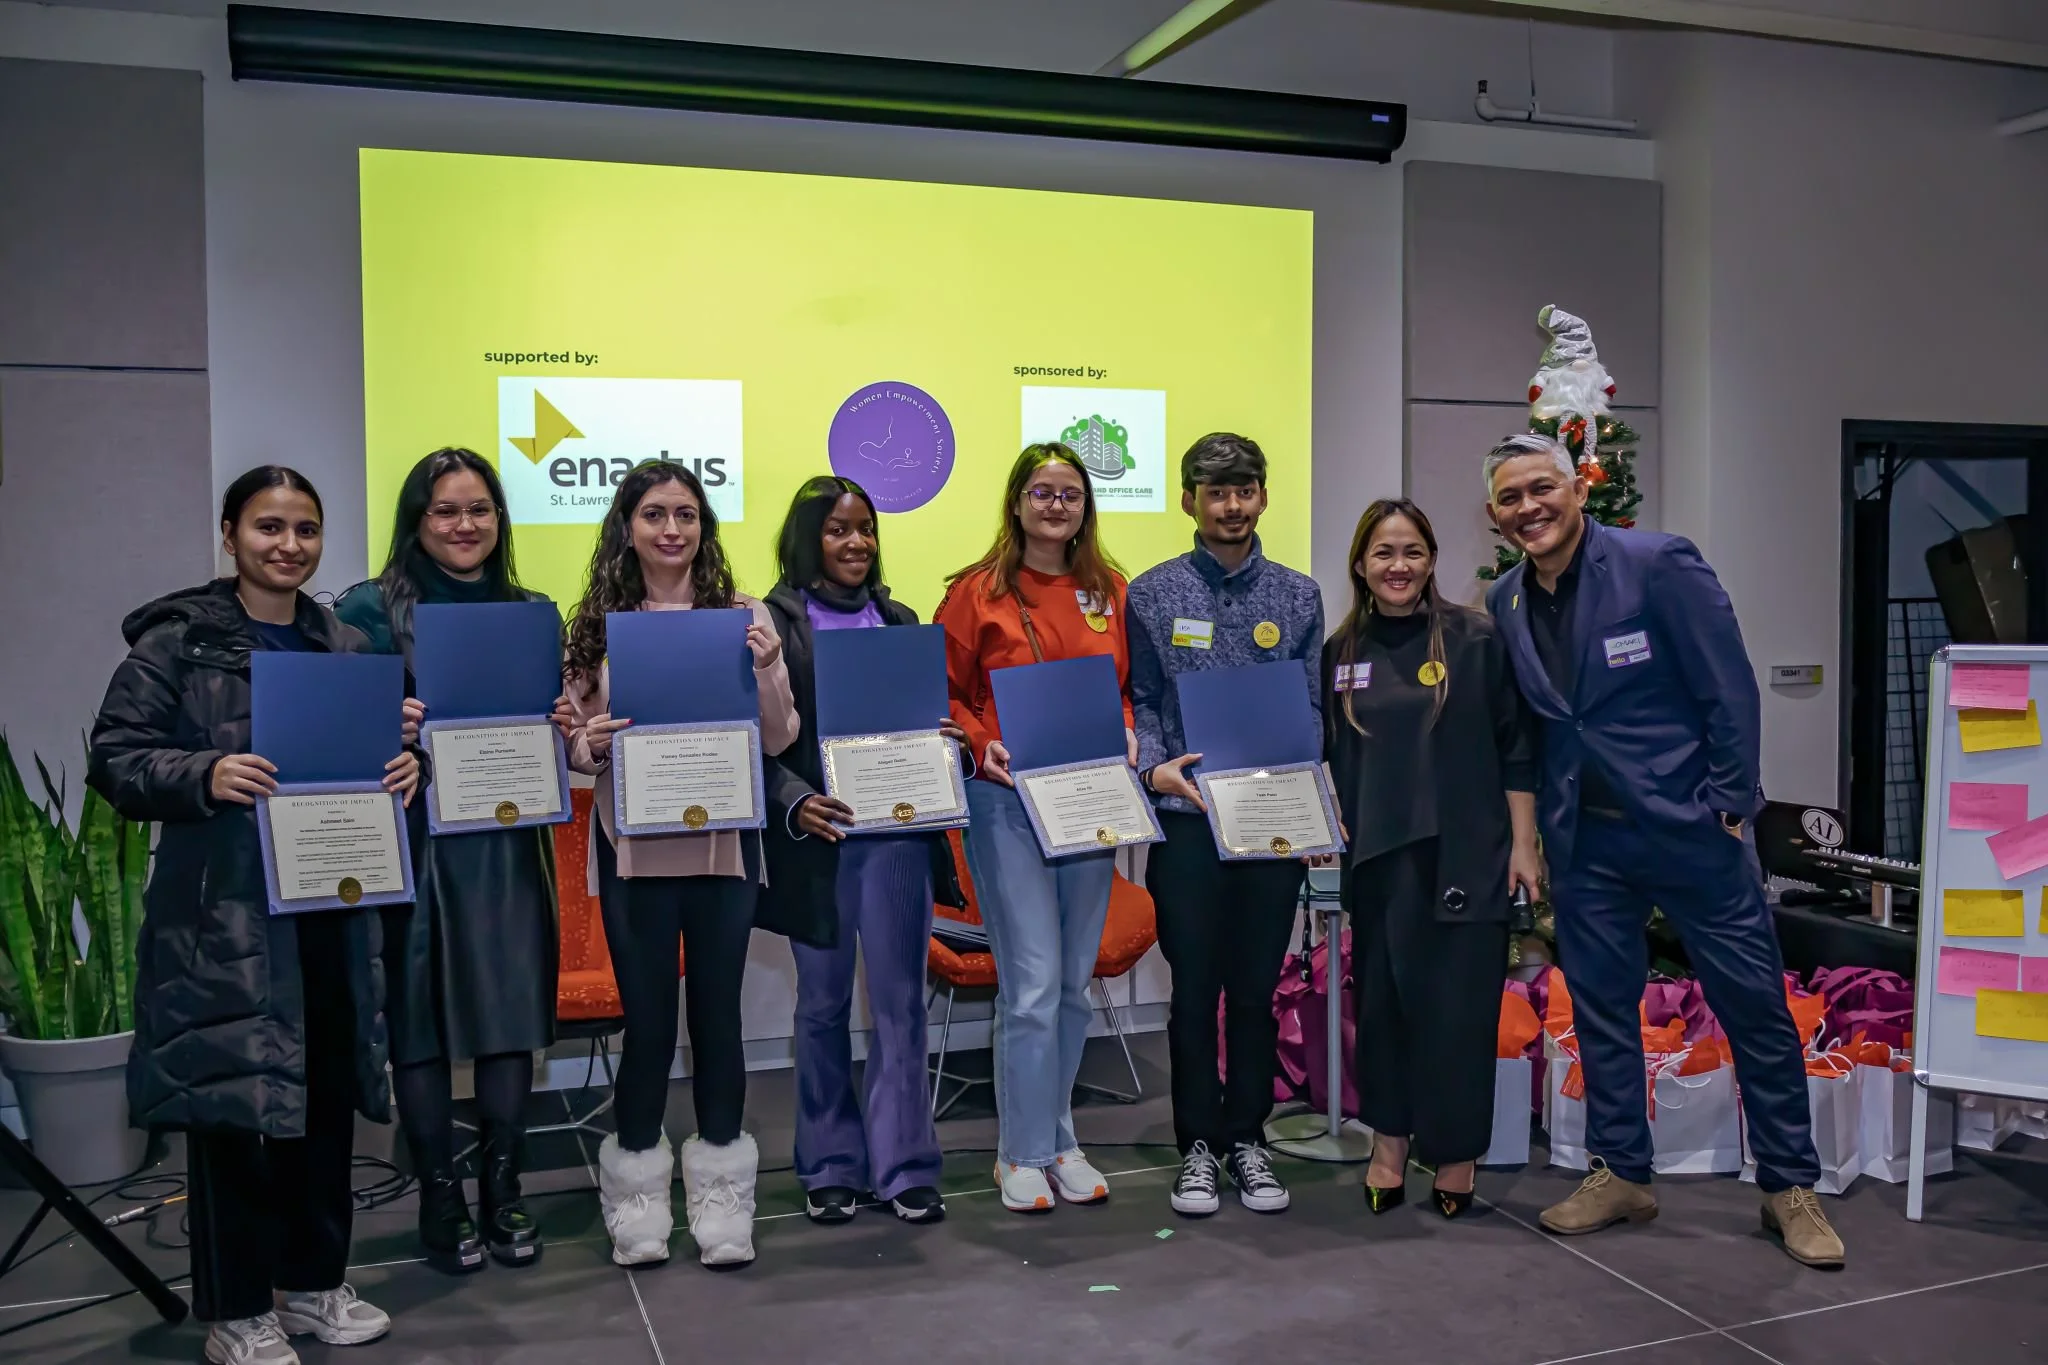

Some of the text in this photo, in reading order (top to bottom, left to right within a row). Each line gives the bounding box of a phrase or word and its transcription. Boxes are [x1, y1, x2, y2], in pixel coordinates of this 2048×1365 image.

[484, 350, 599, 366] supported by:
[1013, 365, 1108, 380] sponsored by:
[849, 390, 944, 474] Women Empowerment Society
[548, 450, 727, 488] enaus
[550, 494, 567, 505] St.
[1608, 656, 1626, 666] hello
[453, 732, 499, 740] RECOGNITION
[646, 737, 692, 745] RECOGNITION
[851, 746, 893, 754] RECOGNITION
[291, 800, 338, 808] RECOGNITION
[1808, 815, 1836, 842] AI
